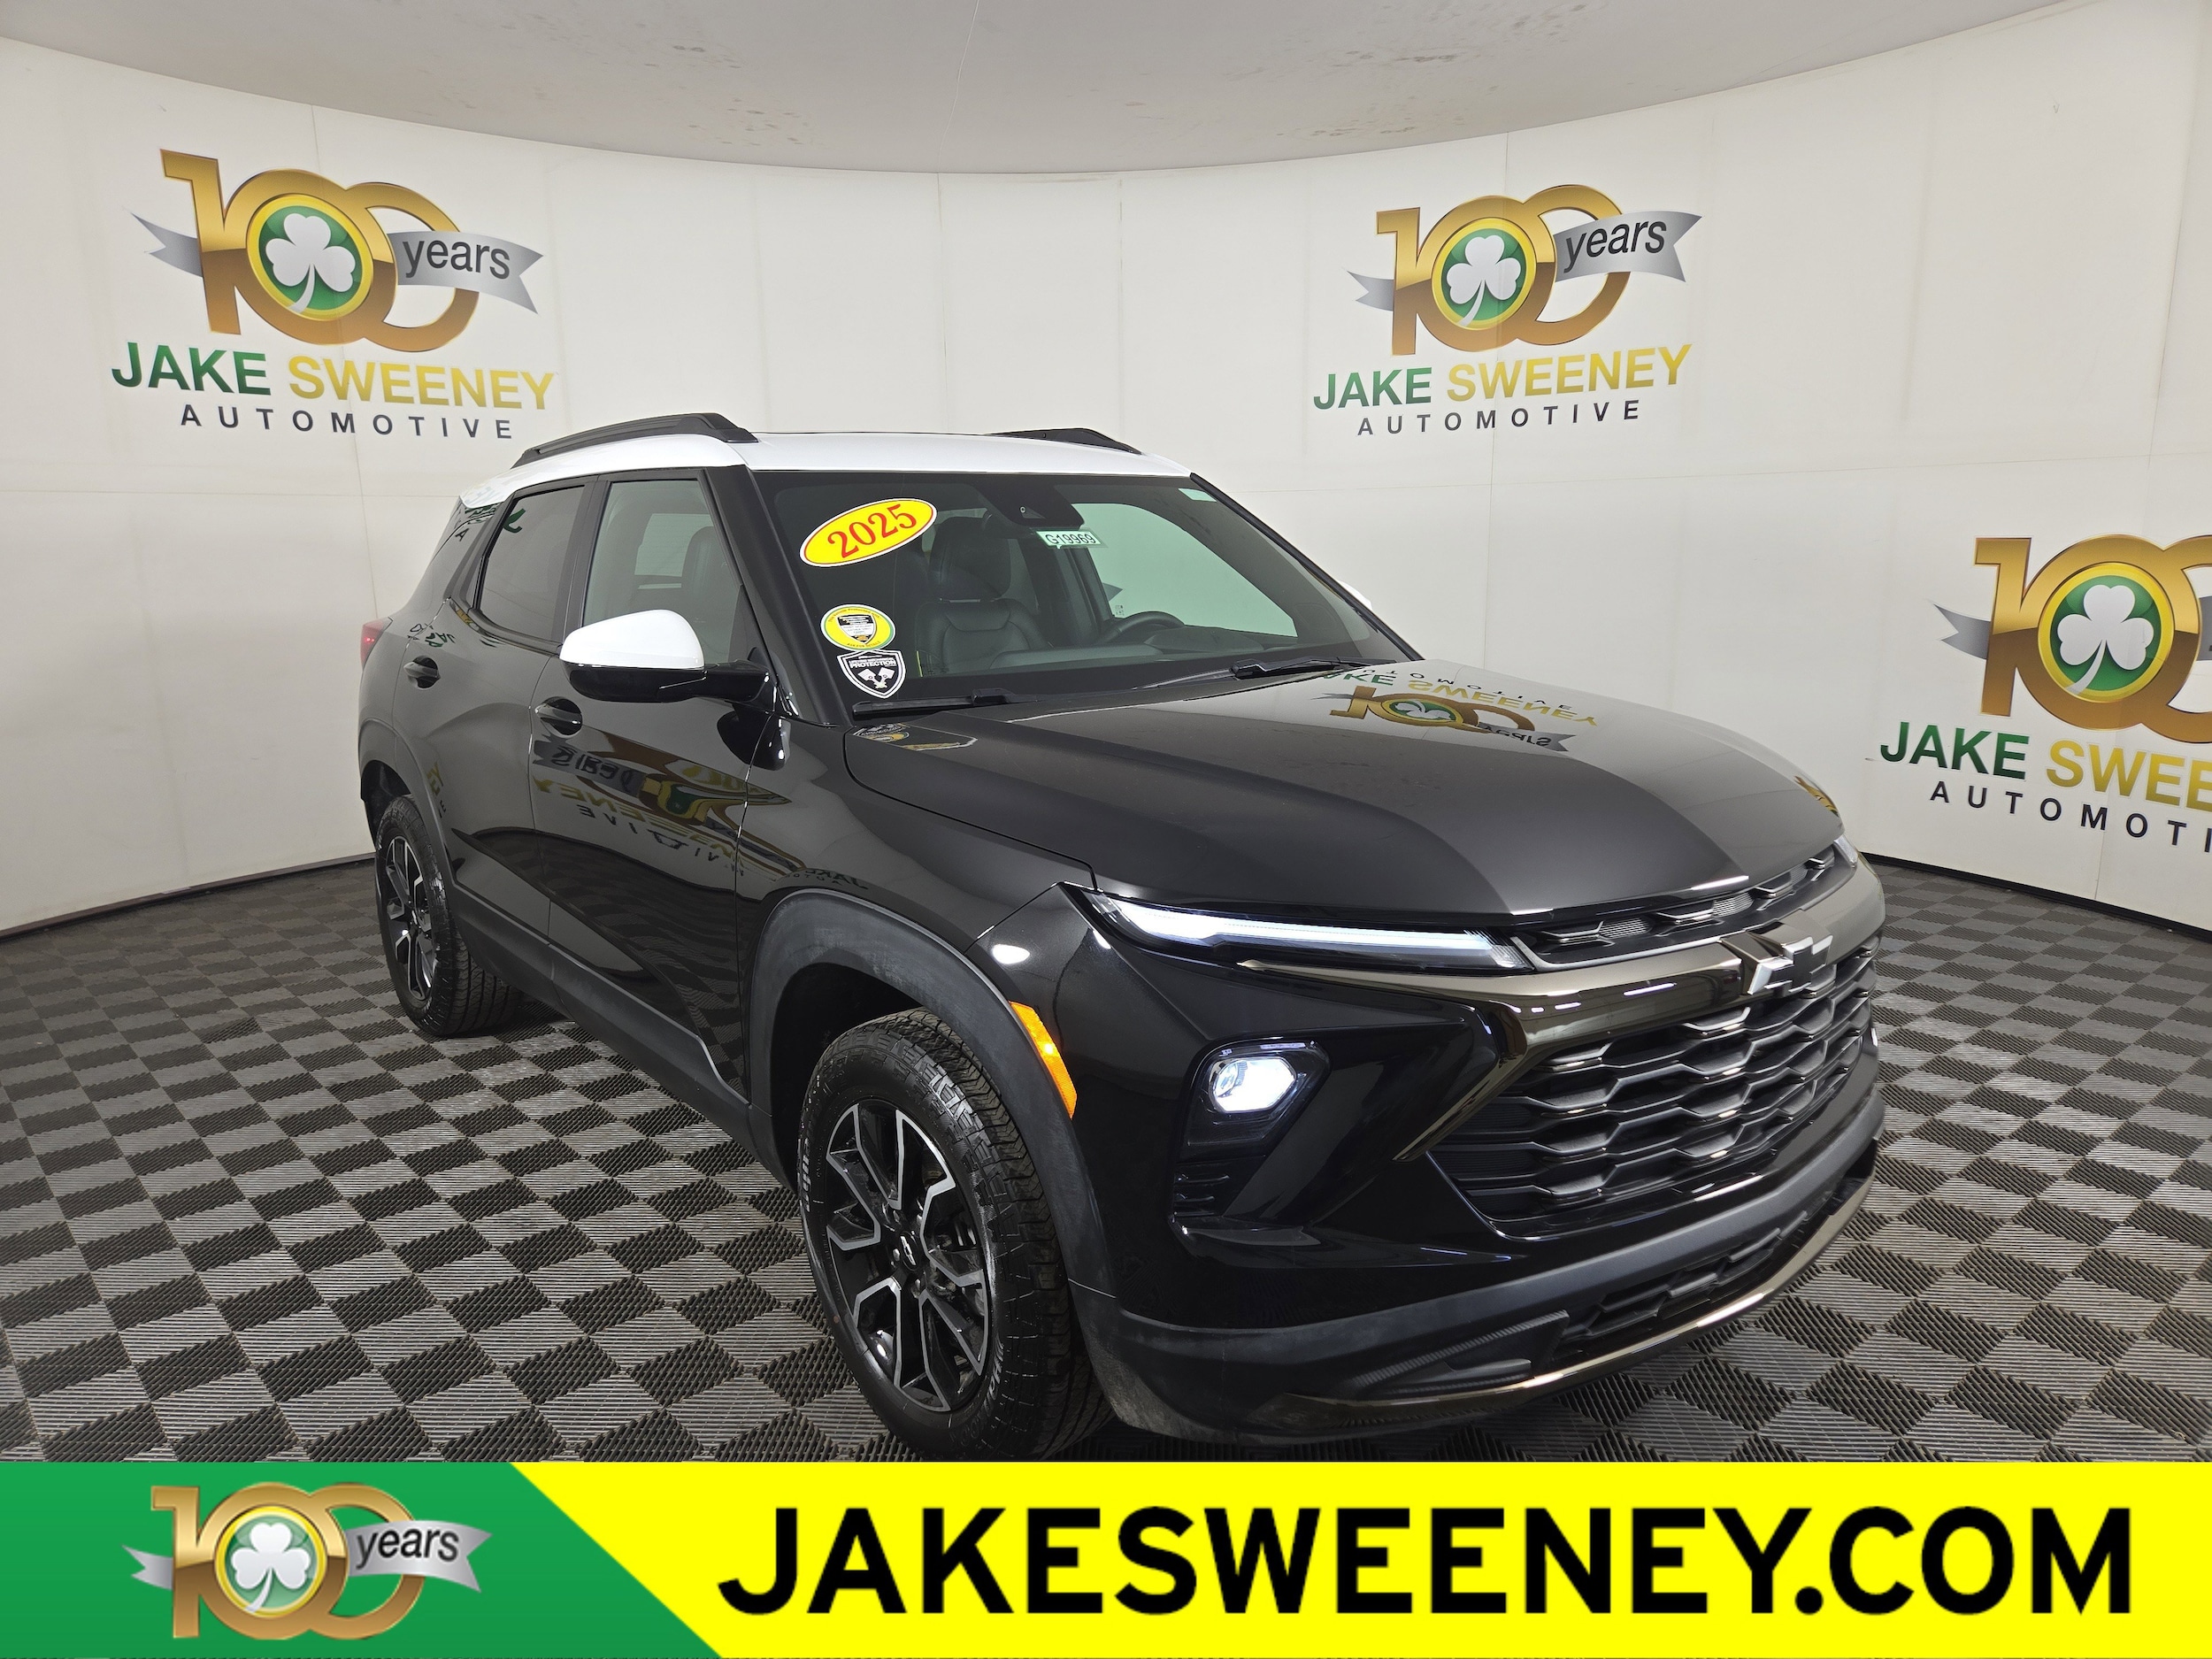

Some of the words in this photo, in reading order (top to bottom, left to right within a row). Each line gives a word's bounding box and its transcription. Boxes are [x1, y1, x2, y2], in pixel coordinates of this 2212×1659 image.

[159, 149, 480, 352] 100
[403, 240, 511, 280] years
[1376, 184, 1631, 356] 100
[1563, 219, 1668, 273] years
[111, 342, 271, 396] JAKE
[288, 355, 554, 410] SWEENEY
[1313, 367, 1432, 411] JAKE
[1447, 344, 1692, 402] SWEENEY
[180, 404, 511, 439] AUTOMOTIVE
[1357, 400, 1639, 436] AUTOMOTIVE
[827, 503, 917, 558] 2025
[1045, 534, 1096, 545] G19969
[849, 659, 897, 669] PROTECTION
[1880, 721, 2030, 780] JAKE
